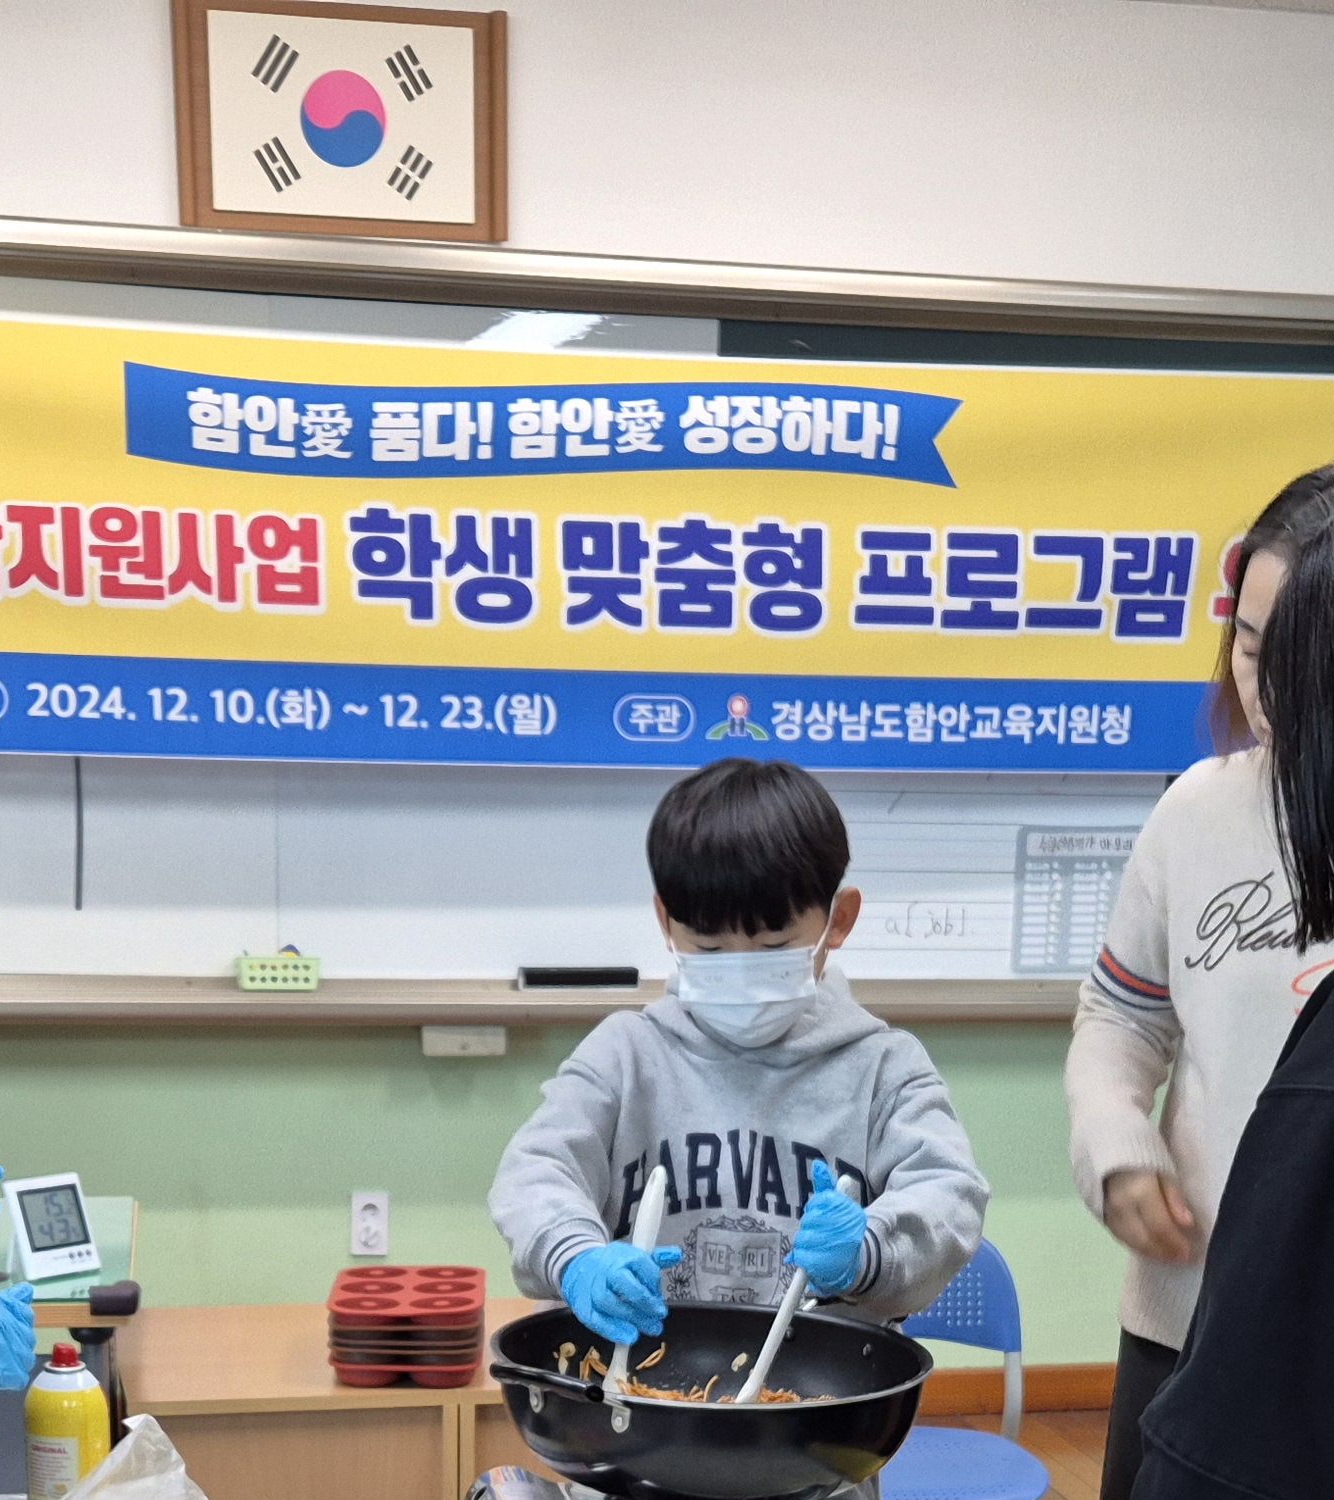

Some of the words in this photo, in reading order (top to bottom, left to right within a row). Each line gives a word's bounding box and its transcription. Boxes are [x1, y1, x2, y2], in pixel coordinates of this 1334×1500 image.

[186, 386, 354, 460] 함안愛
[369, 400, 495, 463] 품다!
[506, 396, 665, 460] 함안愛
[678, 394, 900, 462] 성장하다!
[349, 506, 536, 625] 학생
[560, 518, 825, 633] 맞춤형
[854, 529, 1197, 639] 프로그램
[26, 682, 137, 721] 2024.
[148, 687, 199, 723] 12.
[210, 688, 331, 731] 10.(화)
[380, 693, 429, 729] 12.
[440, 694, 558, 736] 23.(월)
[630, 704, 681, 734] 주관
[771, 700, 1132, 746] 경상남도함안교육지원청
